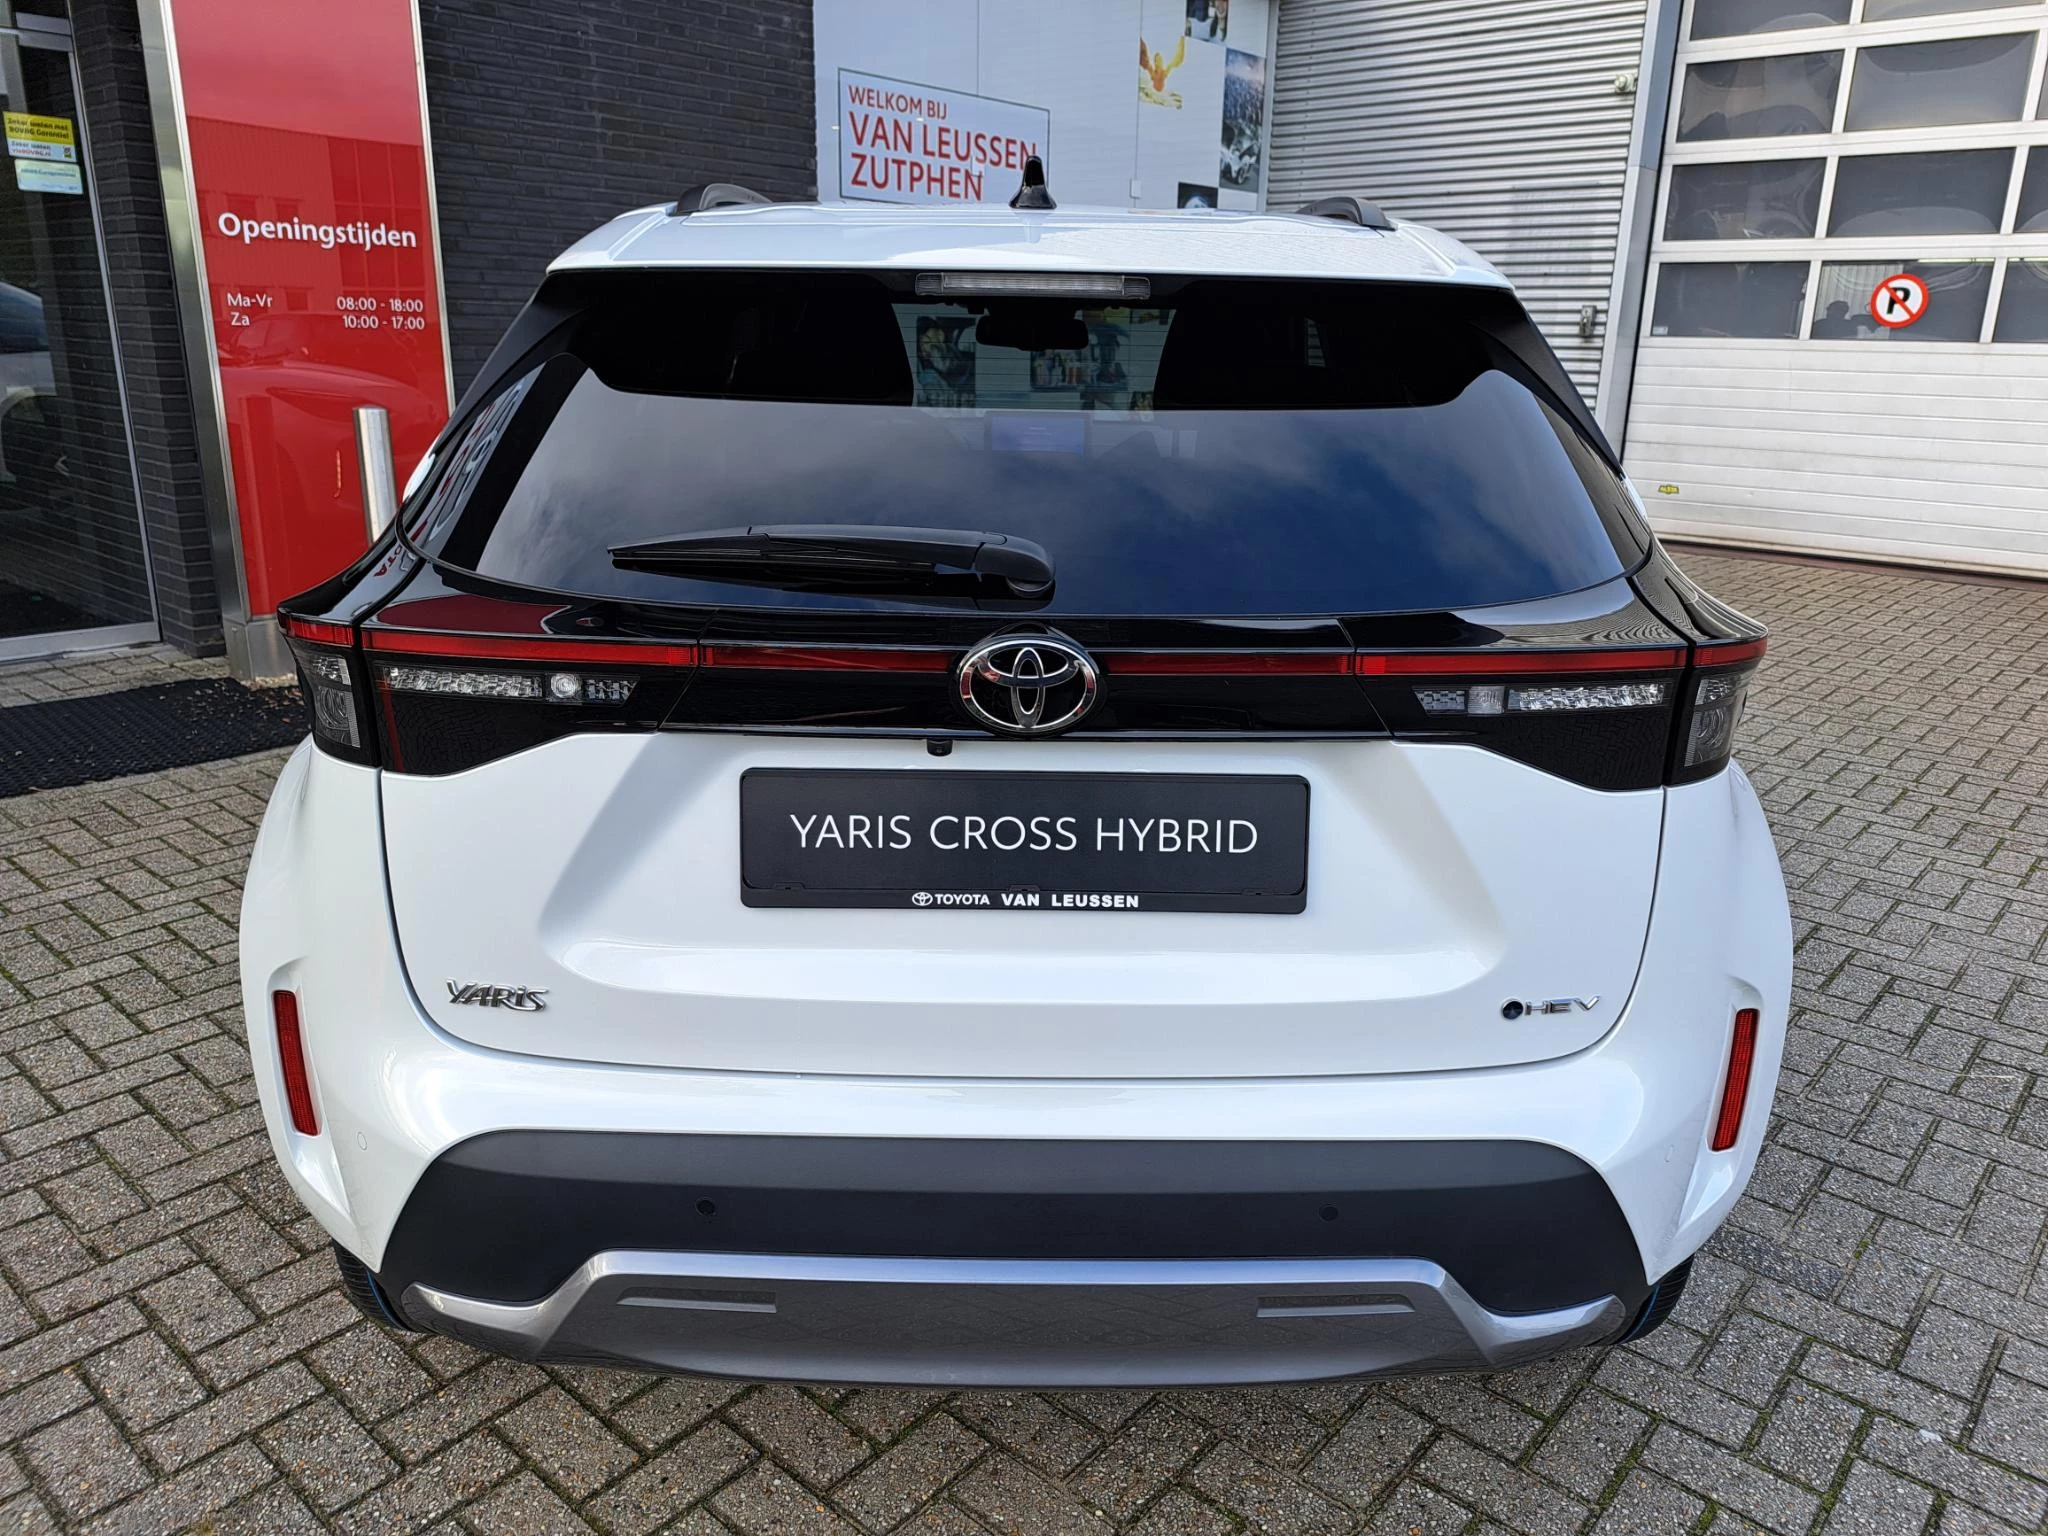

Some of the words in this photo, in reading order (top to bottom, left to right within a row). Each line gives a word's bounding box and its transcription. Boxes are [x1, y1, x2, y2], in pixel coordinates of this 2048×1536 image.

[848, 84, 923, 116] WELKOM
[927, 100, 948, 121] BIJ
[848, 110, 913, 154] VAN
[922, 123, 1037, 171] LEUSSEN
[850, 151, 984, 202] ZUTPHEN
[218, 212, 417, 251] Openingstijden
[226, 292, 273, 308] Ma-Vr
[336, 296, 377, 311] 08:00
[389, 298, 423, 312] 18:00
[1886, 287, 1911, 315] P
[231, 311, 250, 326] Za
[342, 315, 379, 329] 10:00
[392, 316, 425, 330] 17:00
[789, 813, 912, 849] YARIS
[929, 815, 1077, 851] CROSS
[1096, 818, 1258, 854] HYBRID
[935, 893, 991, 906] TOYOTA
[1001, 893, 1040, 908] VAN
[1051, 893, 1139, 909] LEUSSEN
[1524, 996, 1602, 1016] HEV
